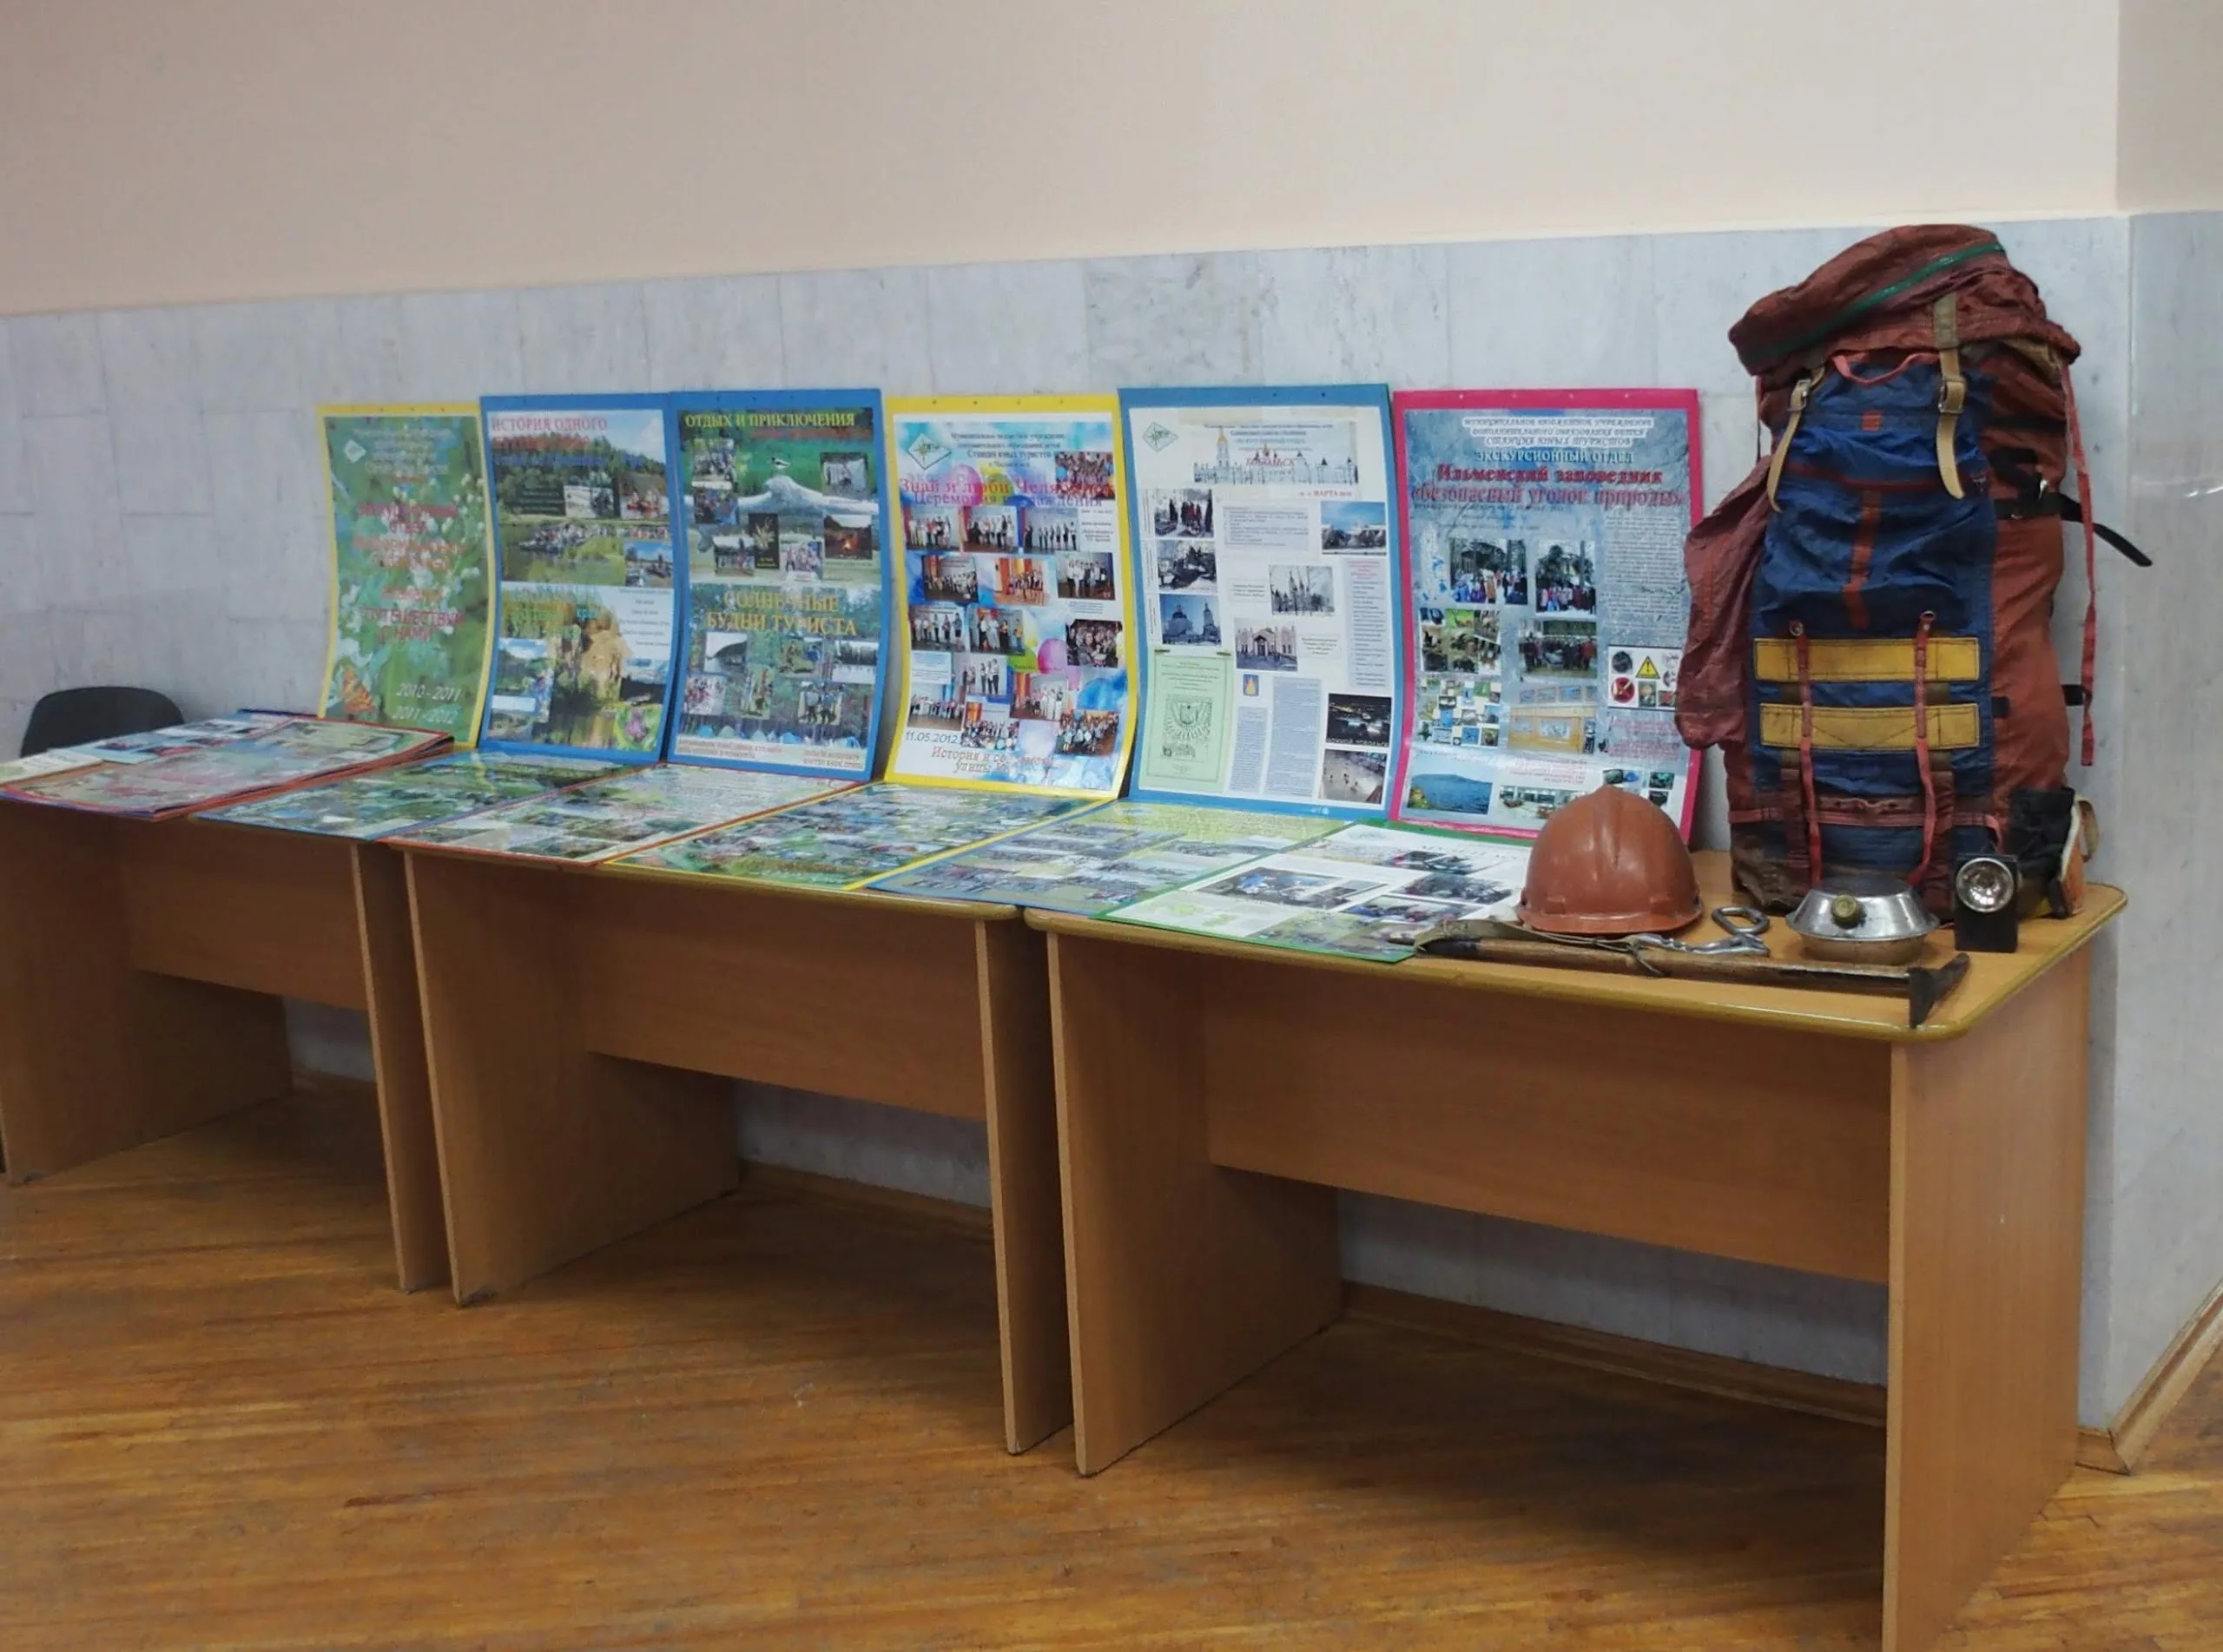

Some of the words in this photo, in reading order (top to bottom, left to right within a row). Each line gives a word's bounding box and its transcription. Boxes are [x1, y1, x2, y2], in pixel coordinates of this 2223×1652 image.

[491, 417, 551, 431] ИСТОРИЯ
[554, 417, 608, 431] ОДНОГО
[685, 413, 732, 428] ОТДЫХ
[736, 414, 745, 427] И
[749, 413, 855, 428] ПРИКЛЮЧЕНИЯ
[1436, 463, 1548, 484] Ильменский
[1555, 469, 1663, 484] заповедник
[707, 611, 766, 631] БУДНИ
[396, 682, 425, 698] 2010
[432, 686, 462, 701] 2011
[906, 730, 960, 744] 11.05.2012
[931, 746, 980, 762] История
